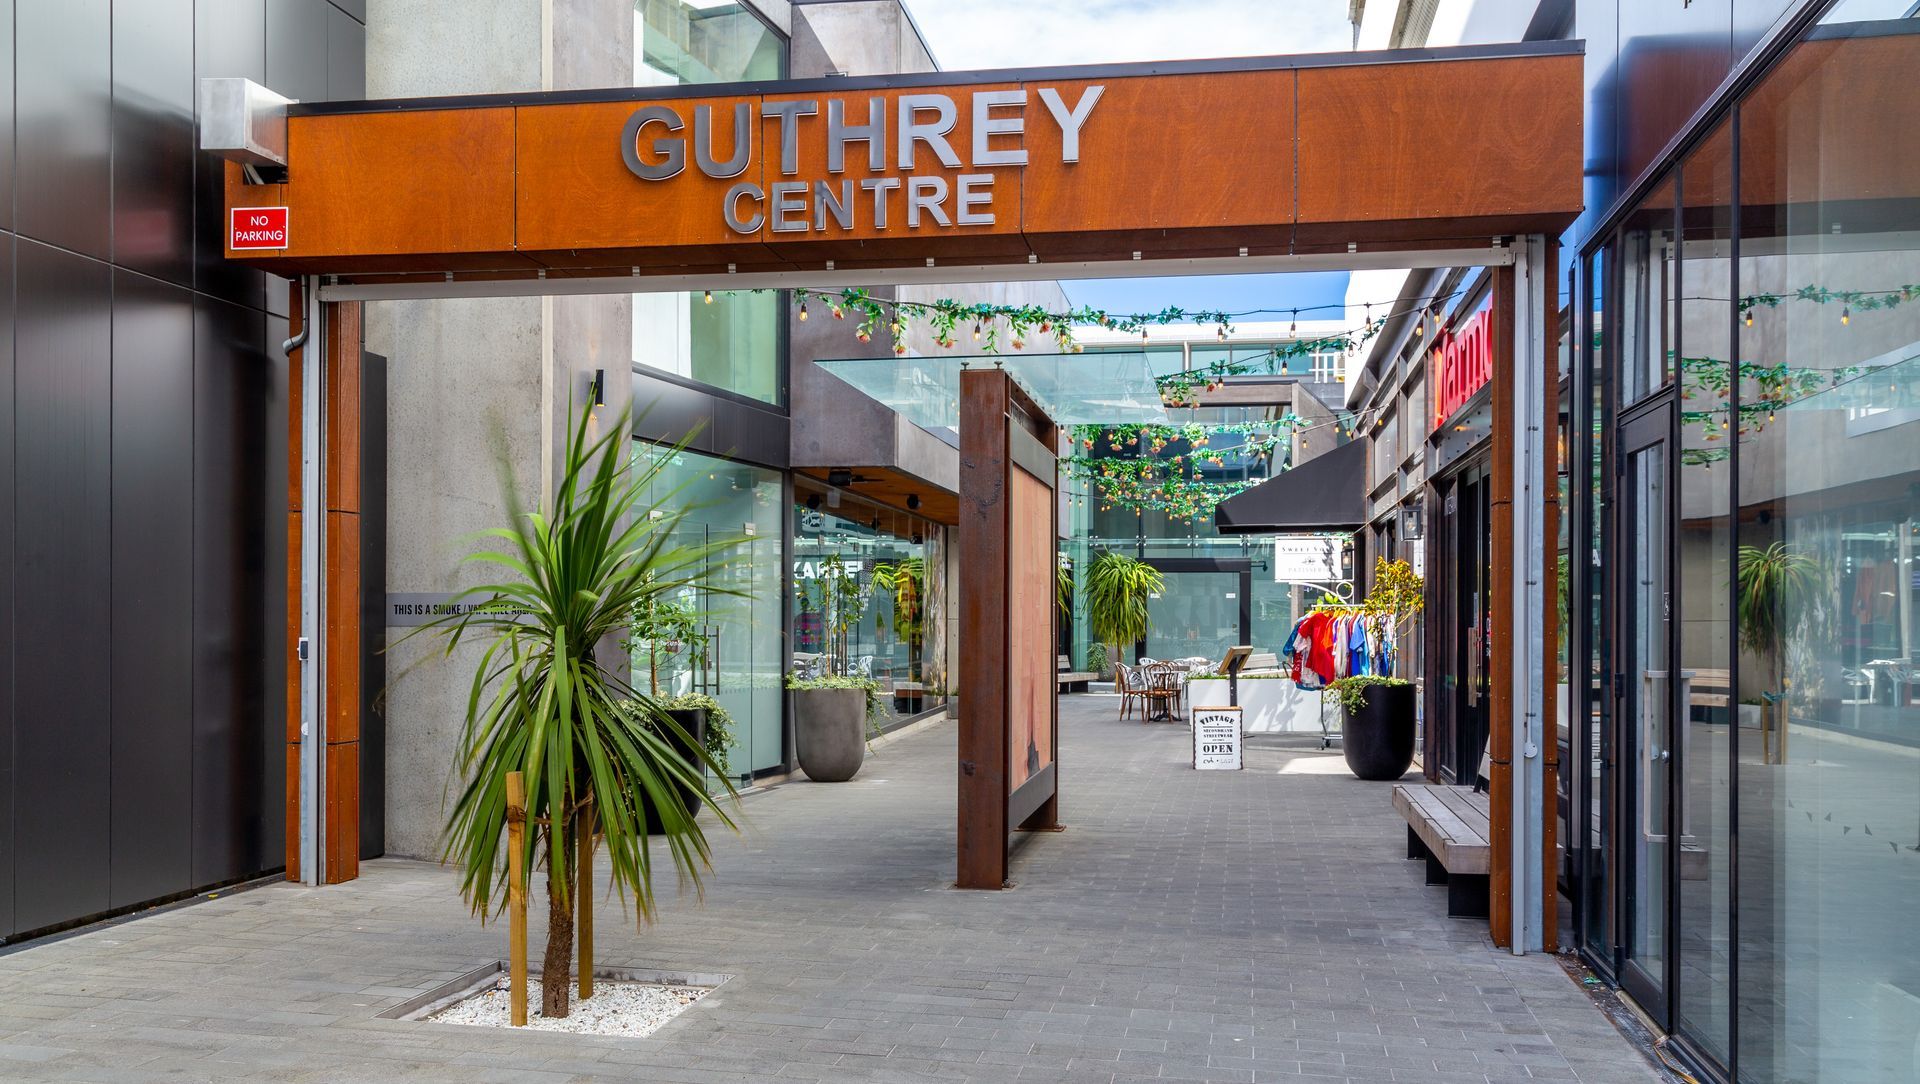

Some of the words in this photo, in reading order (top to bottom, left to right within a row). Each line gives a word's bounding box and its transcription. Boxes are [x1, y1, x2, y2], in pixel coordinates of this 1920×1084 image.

[621, 85, 1106, 181] GUTHREY
[724, 173, 996, 234] CENTRE
[250, 215, 269, 226] NO
[235, 230, 284, 241] PARKING
[394, 604, 412, 615] THIS
[415, 604, 423, 615] IS
[425, 604, 431, 615] A
[433, 604, 461, 615] SMOKE
[1200, 715, 1235, 725] VINTAGE
[1203, 744, 1233, 753] OPEN
